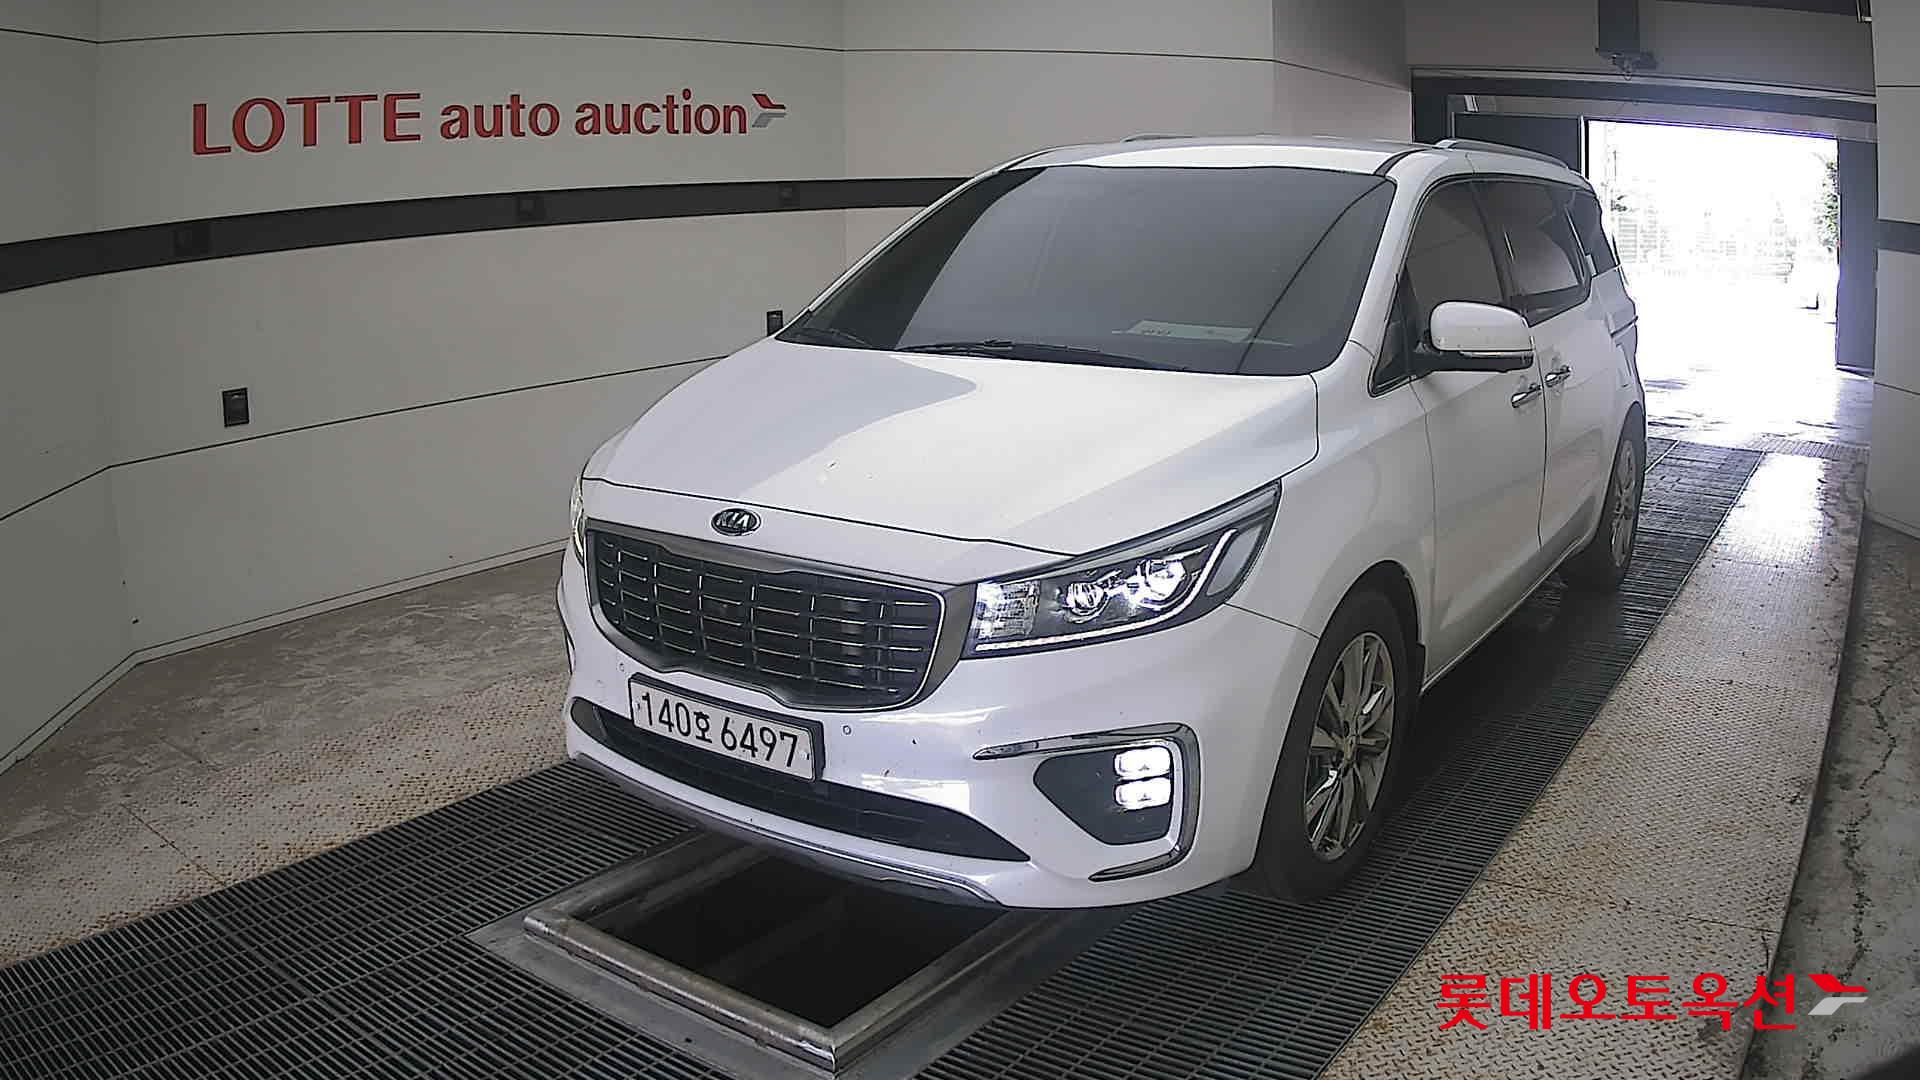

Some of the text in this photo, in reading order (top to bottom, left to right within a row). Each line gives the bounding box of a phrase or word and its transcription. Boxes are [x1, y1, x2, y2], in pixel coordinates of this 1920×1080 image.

[192, 88, 748, 155] LOTTE auto auction
[641, 691, 799, 768] 140호 6497
